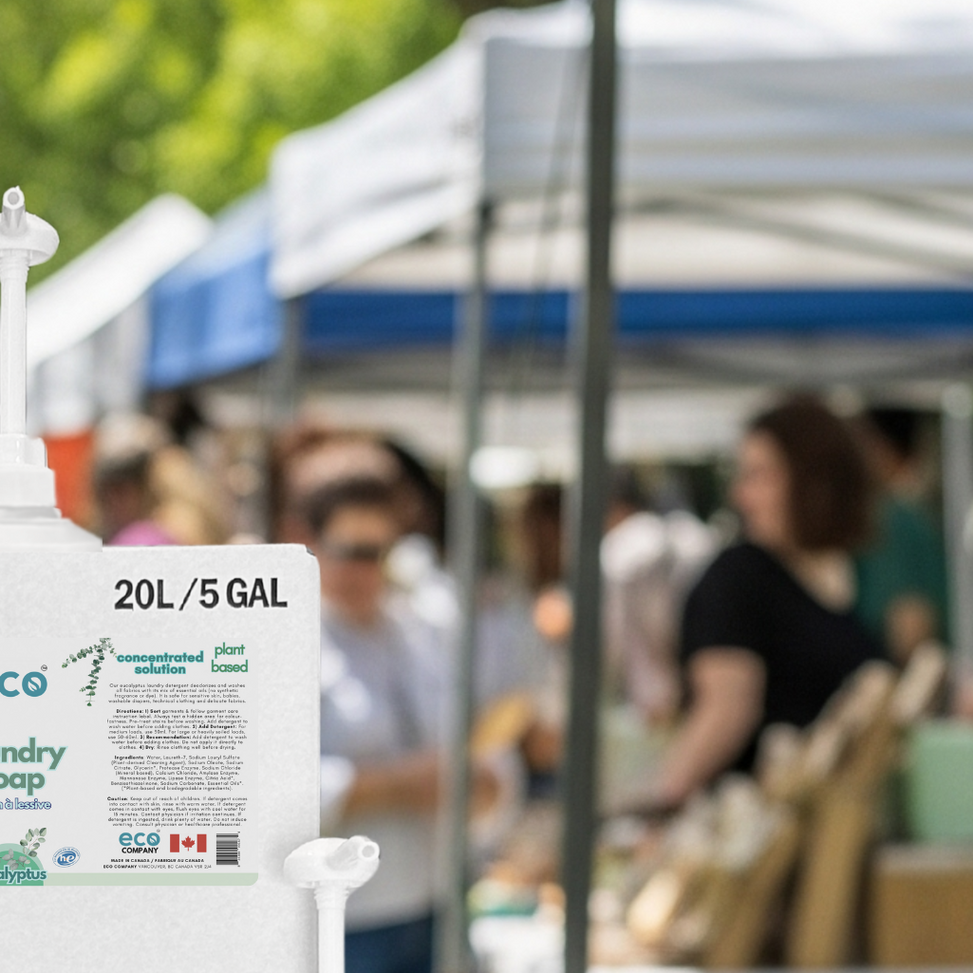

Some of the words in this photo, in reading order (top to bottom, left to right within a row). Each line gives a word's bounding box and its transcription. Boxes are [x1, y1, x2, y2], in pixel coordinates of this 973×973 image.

[226, 577, 288, 608] GAL
[115, 650, 204, 663] concentrated
[214, 642, 246, 659] plant
[134, 663, 187, 675] solution
[211, 659, 249, 673] based
[4, 797, 14, 810] à
[14, 797, 52, 810] lessive
[118, 832, 161, 846] eco
[121, 846, 159, 854] COMPANY
